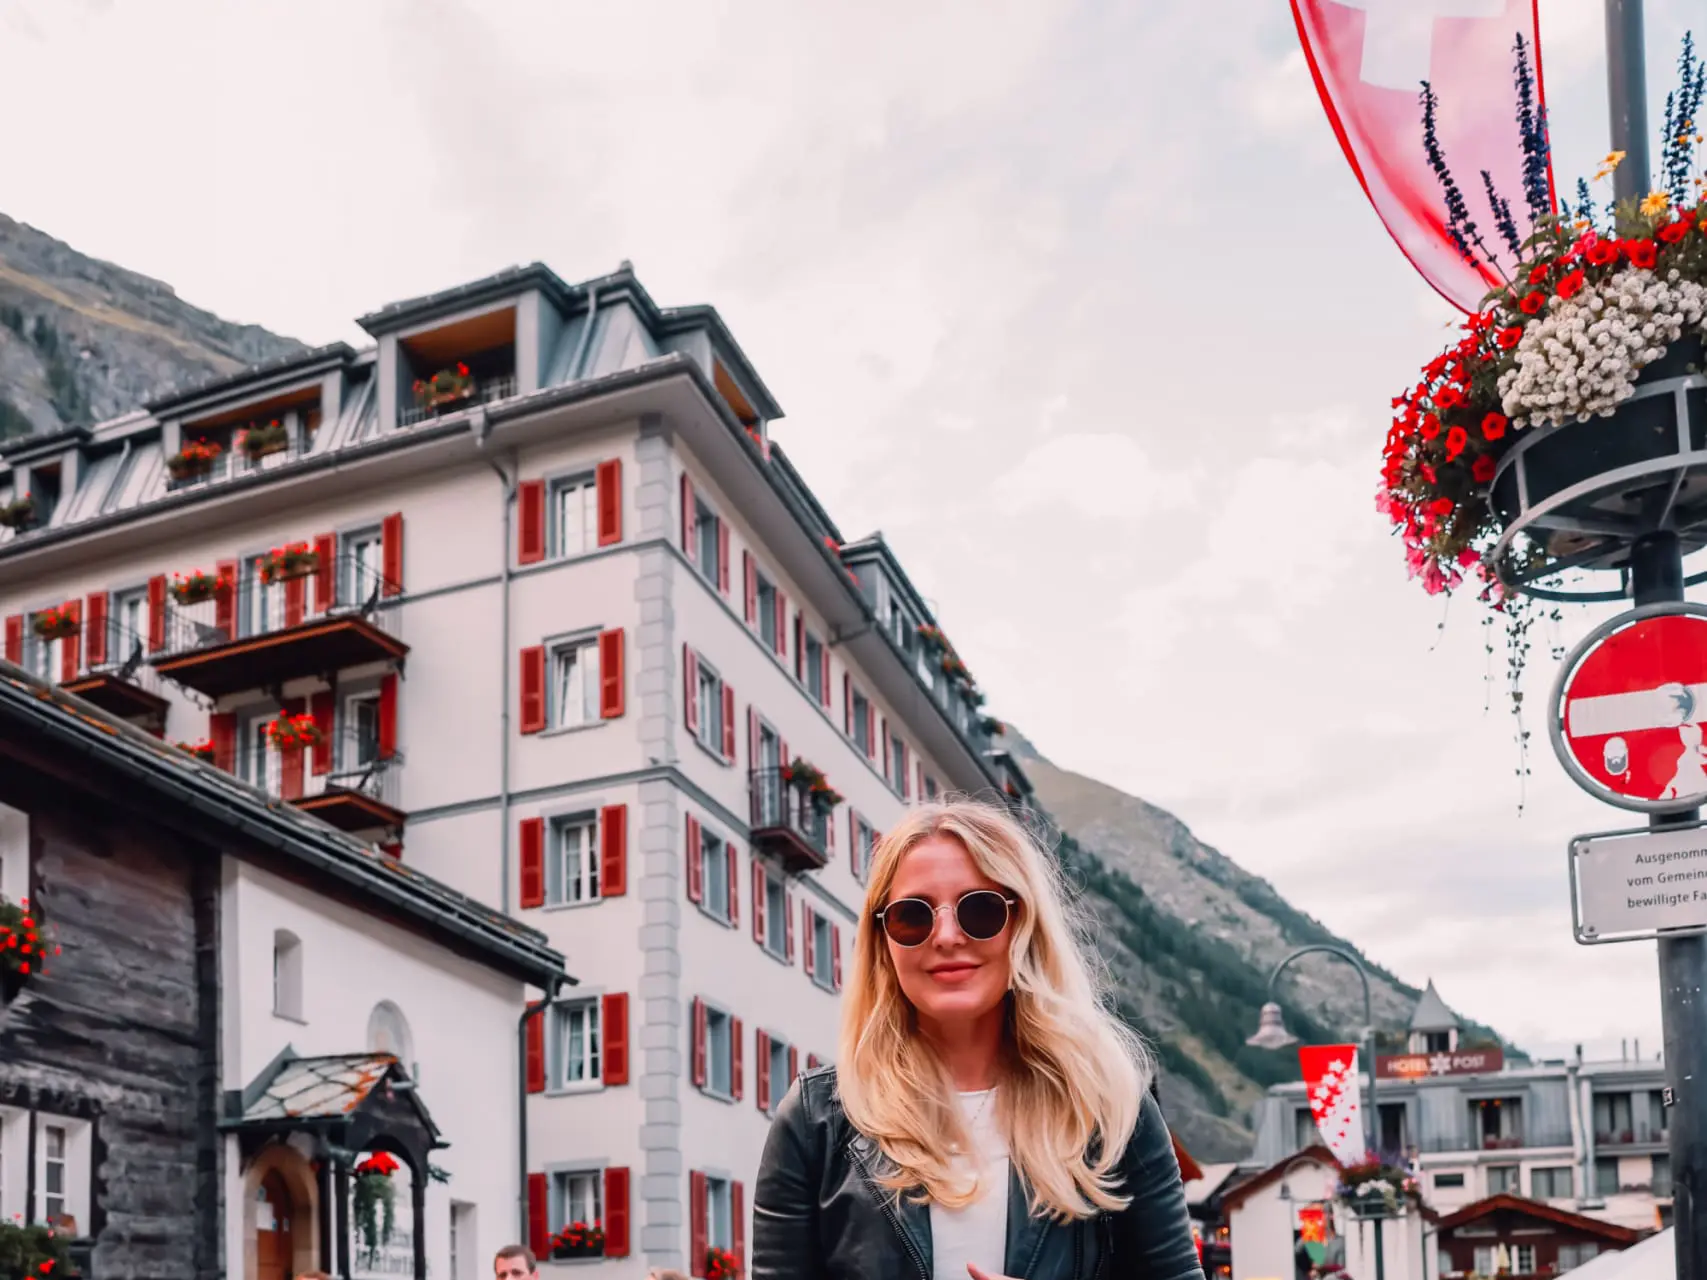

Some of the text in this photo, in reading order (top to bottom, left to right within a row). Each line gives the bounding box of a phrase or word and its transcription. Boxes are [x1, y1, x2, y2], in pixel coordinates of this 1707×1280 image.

[1626, 869, 1707, 887] vom Gemein
[1627, 893, 1689, 908] bewilligte
[1387, 1054, 1485, 1072] HOTEL POST
